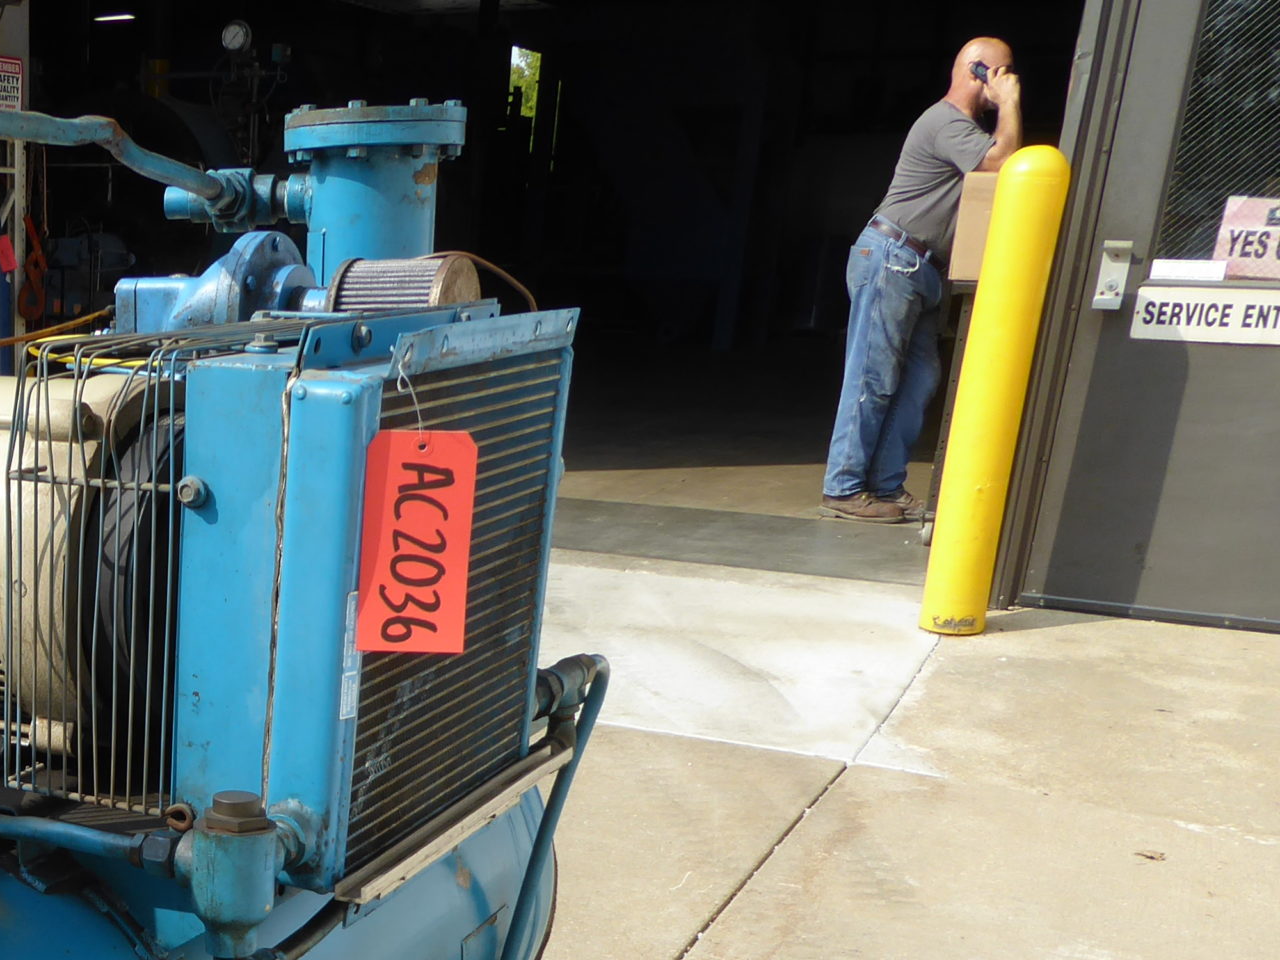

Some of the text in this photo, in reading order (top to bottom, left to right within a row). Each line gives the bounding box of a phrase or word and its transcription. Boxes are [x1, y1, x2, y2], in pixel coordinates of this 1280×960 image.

[1228, 229, 1270, 259] YES
[1142, 301, 1280, 329] SERVICE ENT
[379, 462, 455, 643] AC2036
